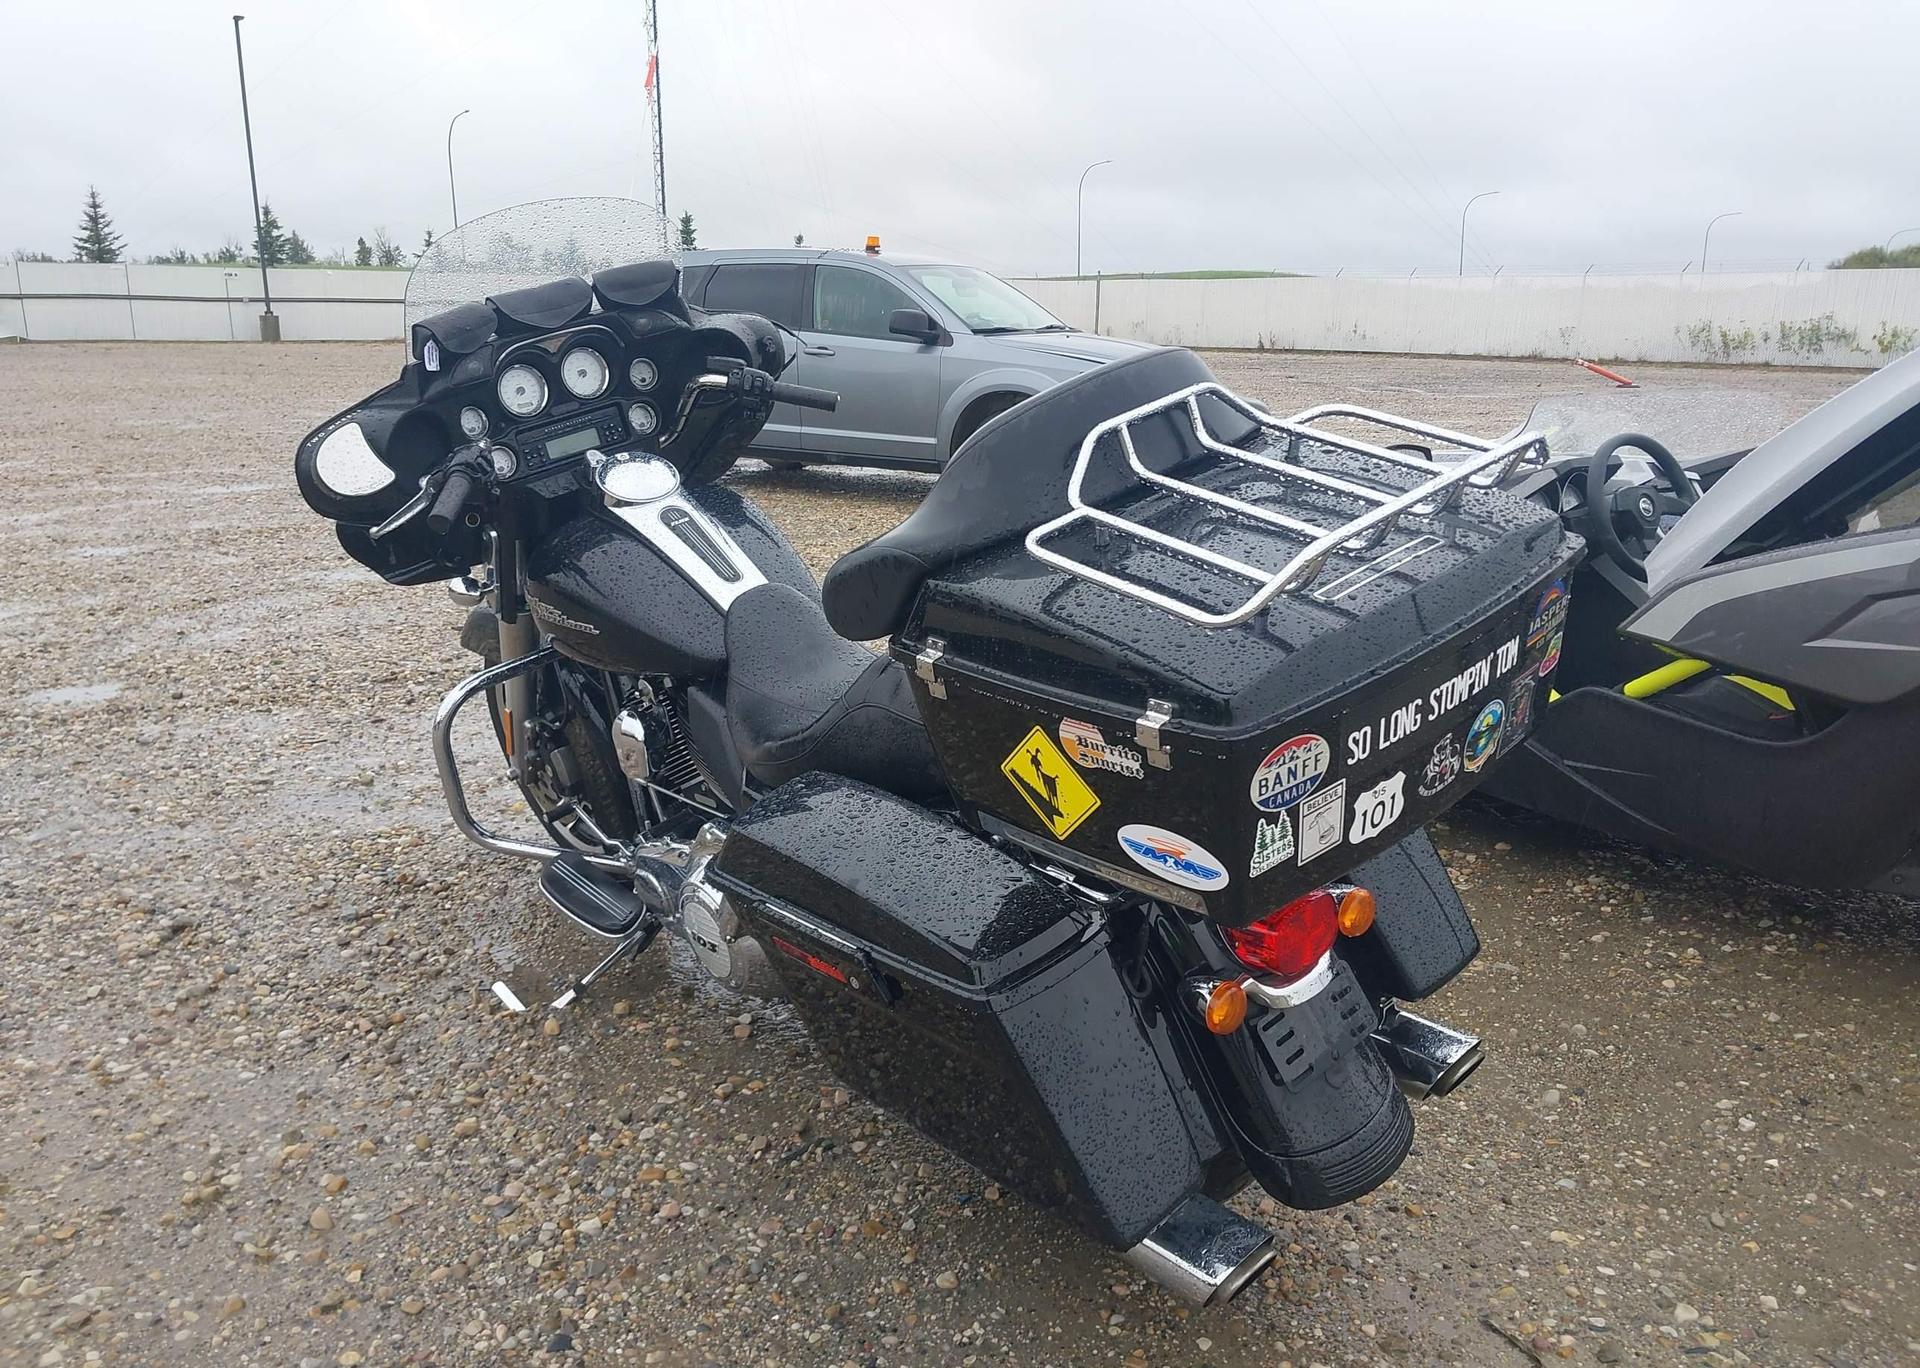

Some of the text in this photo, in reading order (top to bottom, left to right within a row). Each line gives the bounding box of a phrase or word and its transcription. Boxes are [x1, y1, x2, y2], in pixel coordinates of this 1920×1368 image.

[306, 433, 325, 447] TWO
[1528, 594, 1568, 635] JASPER
[1347, 726, 1371, 765] SO
[1378, 697, 1423, 750] LONG
[1428, 651, 1494, 721] STOMPIN'
[1496, 634, 1520, 678] TOM
[1075, 735, 1139, 771] Burrito
[1079, 751, 1143, 779] Sunrise
[1258, 751, 1324, 797] BANFF
[1269, 780, 1312, 808] CANADA
[1307, 788, 1340, 811] BELIEVE
[1372, 786, 1387, 799] US
[1361, 792, 1396, 836] 101
[1251, 850, 1294, 877] OREGON
[1253, 840, 1293, 870] SISTERS
